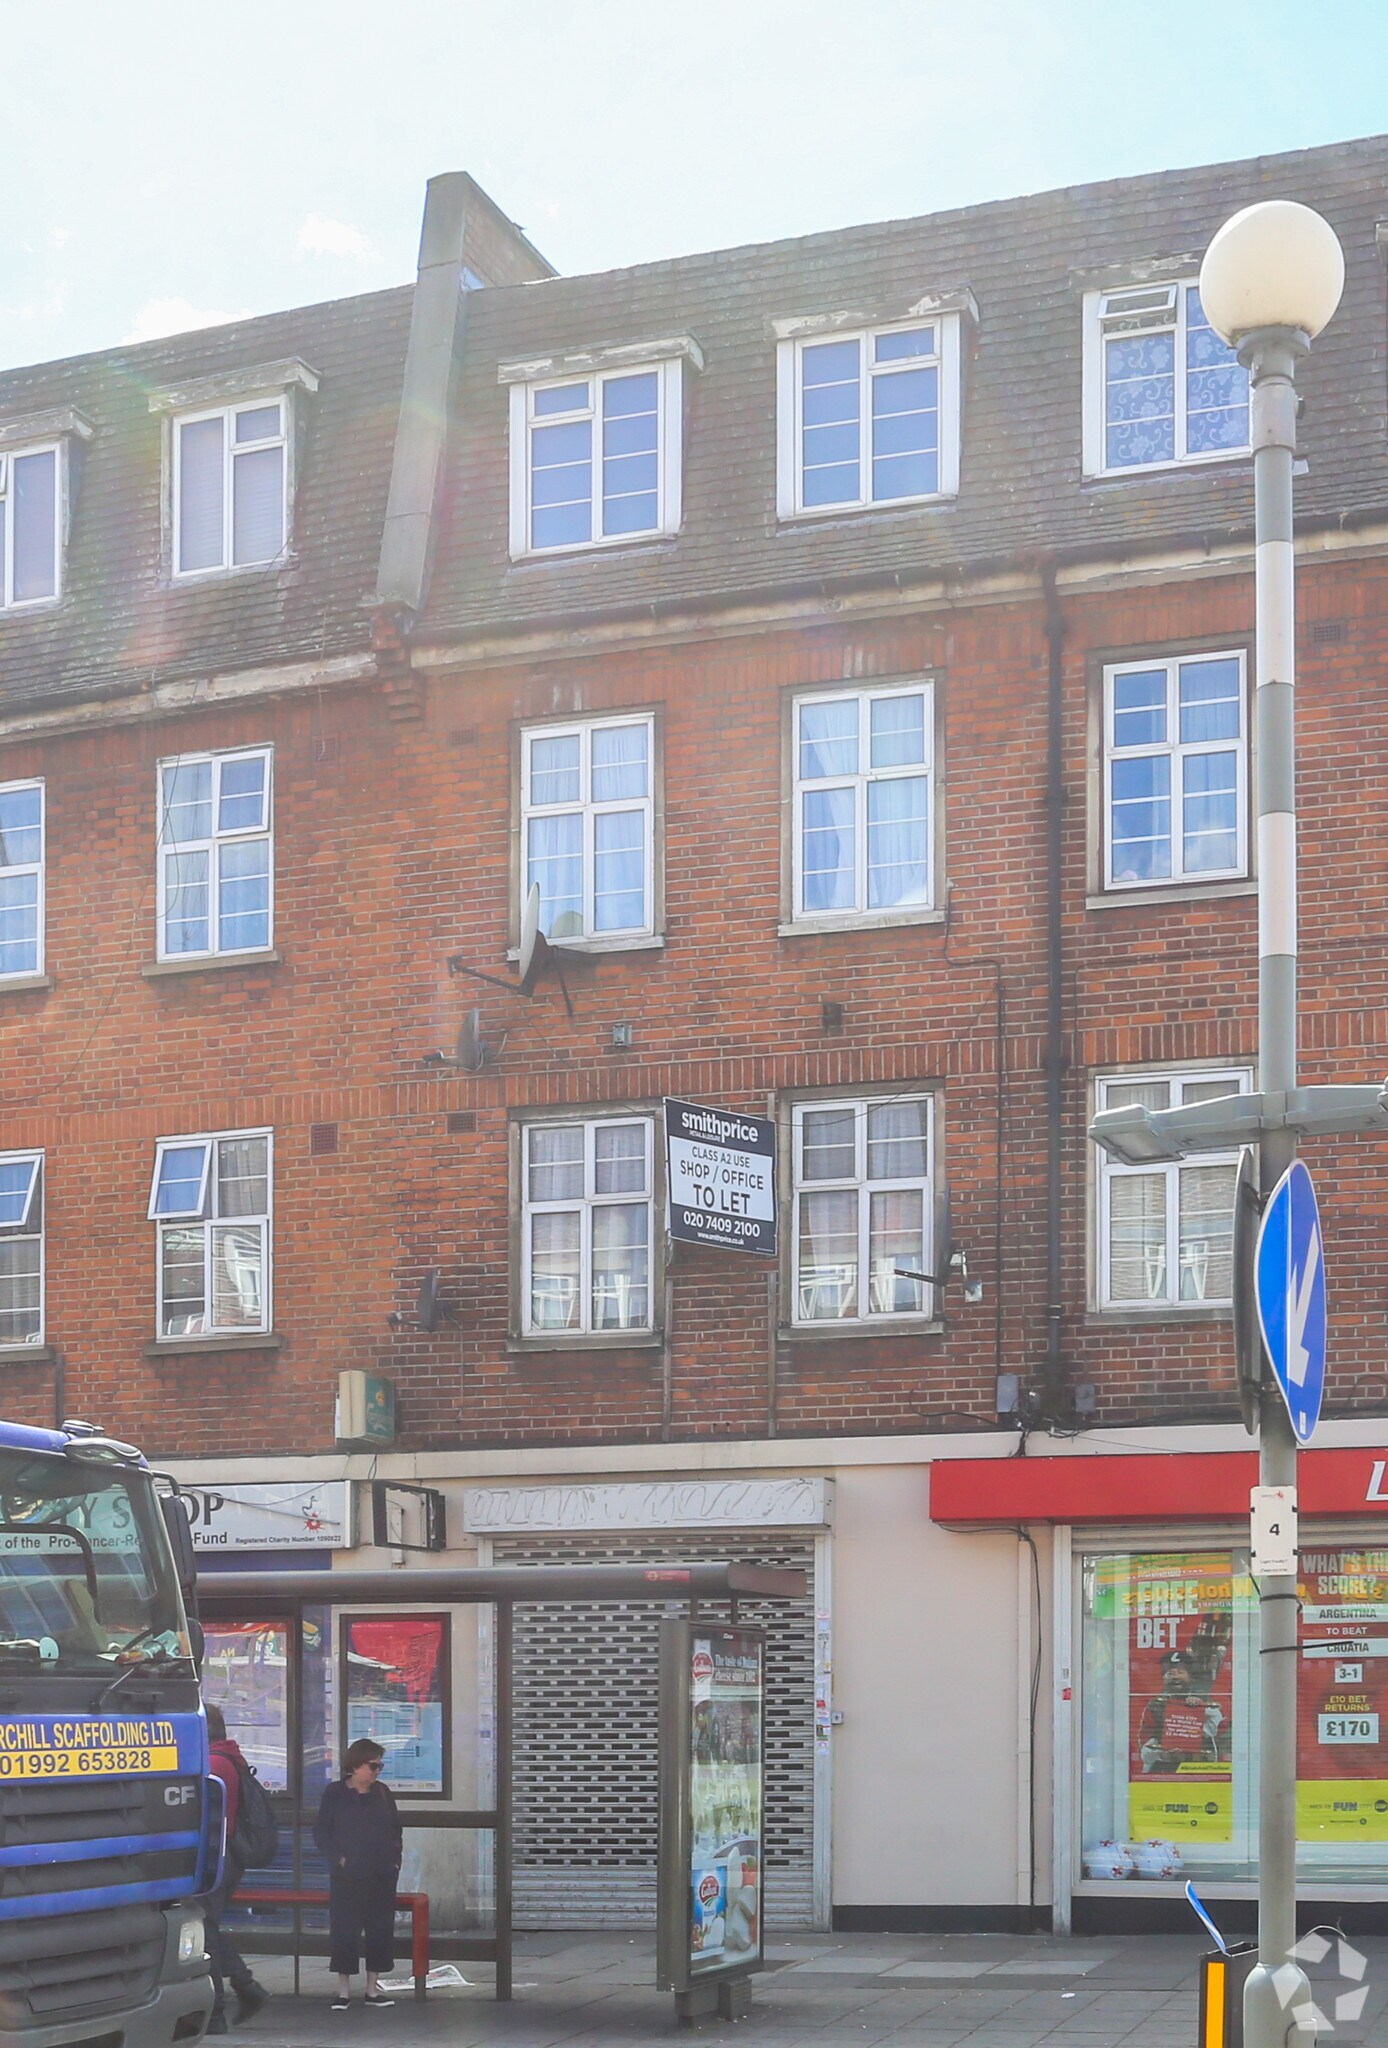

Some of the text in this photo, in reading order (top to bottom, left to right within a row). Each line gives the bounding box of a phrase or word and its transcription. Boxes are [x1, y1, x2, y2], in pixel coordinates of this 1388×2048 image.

[681, 1111, 759, 1143] smithprice
[692, 1146, 750, 1168] CLASS A2 USE
[680, 1160, 710, 1179] SHOP
[721, 1169, 764, 1190] OFFICE
[693, 1184, 751, 1215] TO LET
[683, 1210, 761, 1238] 020 7409 2100
[235, 1537, 268, 1545] Registered
[268, 1536, 290, 1544] Charity
[291, 1535, 315, 1543] Number
[1269, 1523, 1280, 1536] 4
[5, 1537, 18, 1549] of
[21, 1536, 41, 1548] the
[1302, 1553, 1360, 1574] WHAT'S
[1317, 1574, 1377, 1595] SCORE?
[1136, 1580, 1199, 1616] FREE
[1319, 1608, 1377, 1619] ARGENTINA
[1137, 1617, 1181, 1649] BET
[1326, 1626, 1368, 1635] TO BEAT
[1326, 1643, 1369, 1653] CROATIA
[1339, 1667, 1358, 1679] 3-1
[1329, 1695, 1368, 1704] £10 BET
[53, 1721, 149, 1749] SCAFFOLDING
[150, 1721, 177, 1746] LTD.
[1326, 1720, 1371, 1737] £170
[0, 1750, 152, 1776] 01992 653828
[163, 1785, 197, 1806] CF
[1333, 1801, 1358, 1811] FUN
[1165, 1803, 1189, 1813] FUN
